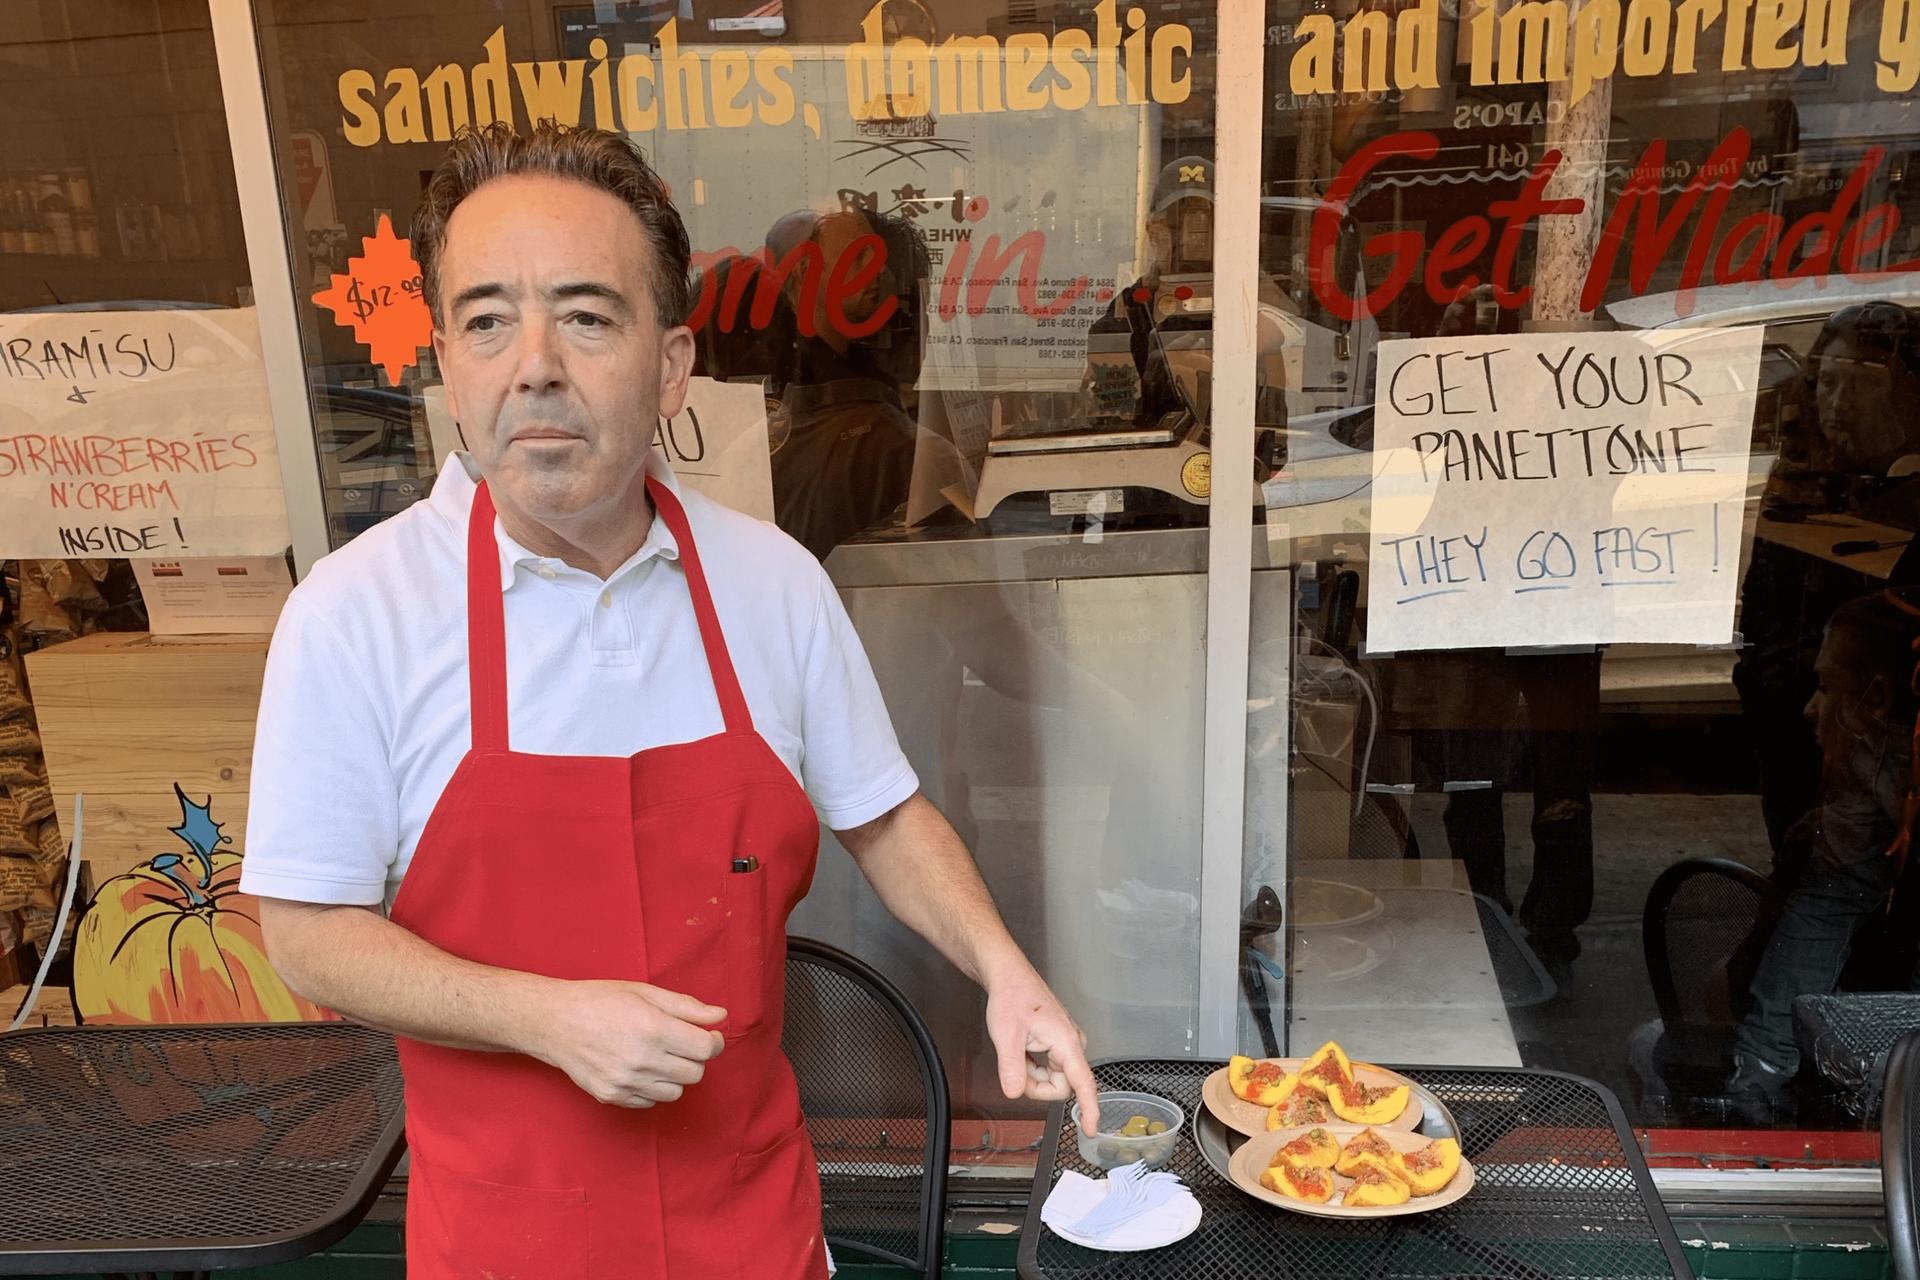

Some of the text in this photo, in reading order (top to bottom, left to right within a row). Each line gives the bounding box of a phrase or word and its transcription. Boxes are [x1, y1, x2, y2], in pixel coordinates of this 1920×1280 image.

[844, 0, 1192, 118] domestic
[1289, 0, 1441, 95] and
[1179, 165, 1205, 182] M
[1308, 125, 1920, 320] Get Made
[684, 234, 898, 337] ome
[1389, 346, 1703, 416] GET YOUR
[1411, 424, 1717, 483] PANETTONE
[1380, 526, 1488, 586] THEY
[1517, 530, 1577, 580] GO
